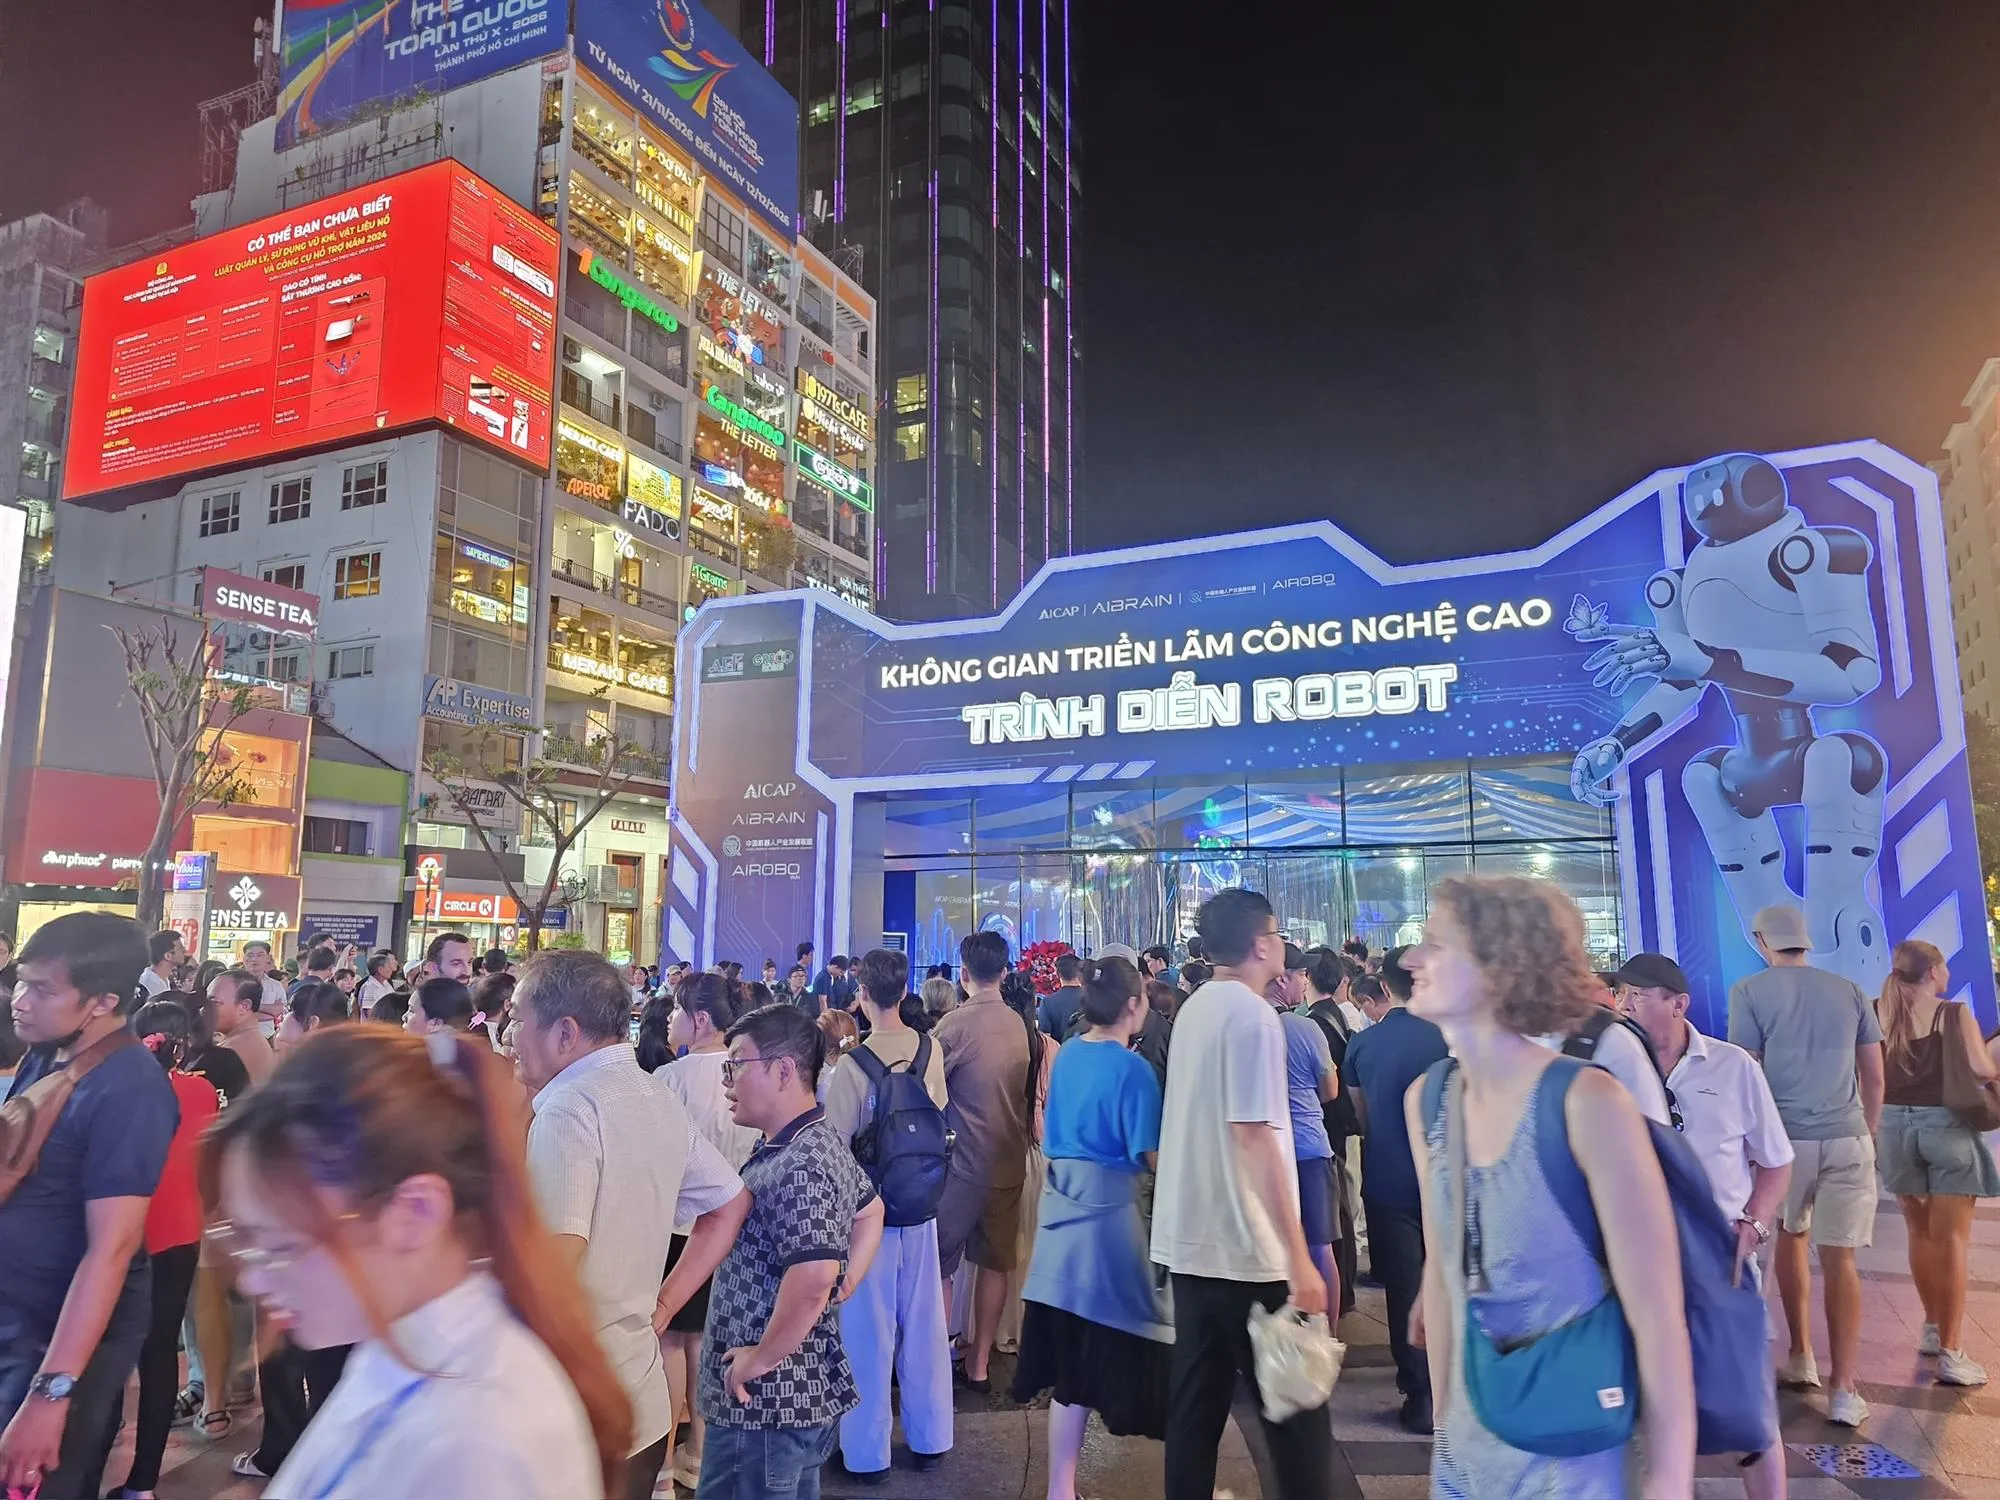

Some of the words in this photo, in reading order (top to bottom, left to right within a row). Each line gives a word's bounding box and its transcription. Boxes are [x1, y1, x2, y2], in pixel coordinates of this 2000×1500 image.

[434, 43, 460, 58] LẦN
[463, 30, 488, 47] THỨ
[492, 26, 501, 37] X
[434, 54, 465, 72] THÀNH
[466, 43, 487, 61] PHỐ
[487, 40, 501, 53] HỒ
[503, 34, 521, 49] CHÍ
[521, 25, 548, 41] MINH
[587, 40, 607, 64] TỪ
[607, 57, 641, 94] NGÀY
[695, 135, 717, 163] ĐẾN
[718, 156, 746, 187] NGÀY
[247, 234, 266, 253] CÓ
[268, 224, 292, 246] THỂ
[294, 218, 321, 240] BẠN
[323, 205, 360, 230] CHƯA
[362, 193, 393, 217] BIẾT
[263, 262, 275, 276] VÀ
[275, 257, 300, 272] CÔNG
[366, 230, 388, 243] 2024
[283, 242, 307, 258] DỤNG
[714, 267, 740, 298] THE
[840, 400, 869, 435] CAFE
[720, 417, 740, 440] THE
[740, 432, 778, 462] LETTER
[566, 477, 612, 501] APEROL
[624, 497, 681, 540] FADO
[216, 586, 276, 617] SENSE
[278, 602, 313, 626] TEA
[1039, 606, 1080, 621] AICAP
[1092, 594, 1172, 614] AIBRAIN
[881, 656, 983, 689] KHÔNG
[987, 650, 1060, 680] GIAN
[1065, 631, 1157, 673] TRIỂN
[1164, 628, 1235, 664] LÃM
[1240, 620, 1342, 655] CÔNG
[1351, 602, 1458, 644] NGHỆ
[1466, 598, 1553, 633] CAO
[562, 652, 623, 683] MERAKI
[425, 705, 468, 724] Accounting
[463, 689, 530, 720] Expertise
[961, 691, 1106, 745] TRÌNH
[1117, 670, 1242, 734] DIỄN
[1252, 663, 1458, 724] ROBOT
[743, 782, 796, 799] AICAP
[732, 811, 807, 826] AIBRAIN
[210, 909, 252, 928] ENSE
[254, 910, 289, 928] TEA
[444, 901, 477, 912] CIRCLE
